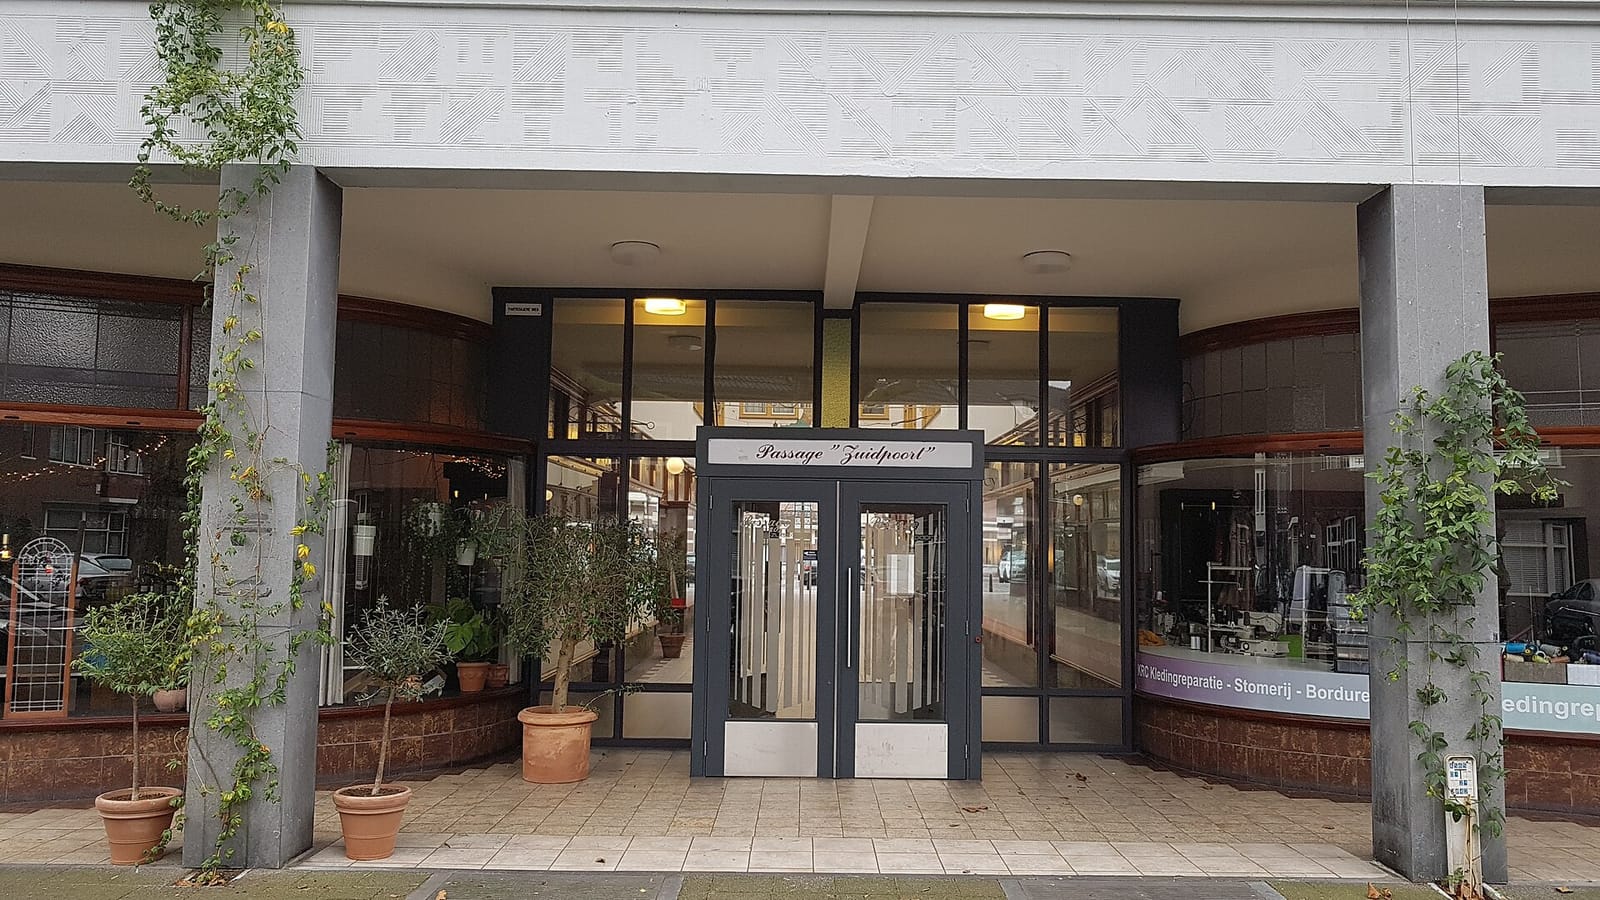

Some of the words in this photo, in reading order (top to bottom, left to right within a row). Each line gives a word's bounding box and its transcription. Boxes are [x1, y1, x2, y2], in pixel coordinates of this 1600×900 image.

[756, 444, 824, 465] Passage
[1137, 664, 1149, 679] KRC
[1150, 666, 1224, 690] Kledingreparatie
[1234, 678, 1292, 701] Stomerij
[1305, 683, 1370, 703] Bordure
